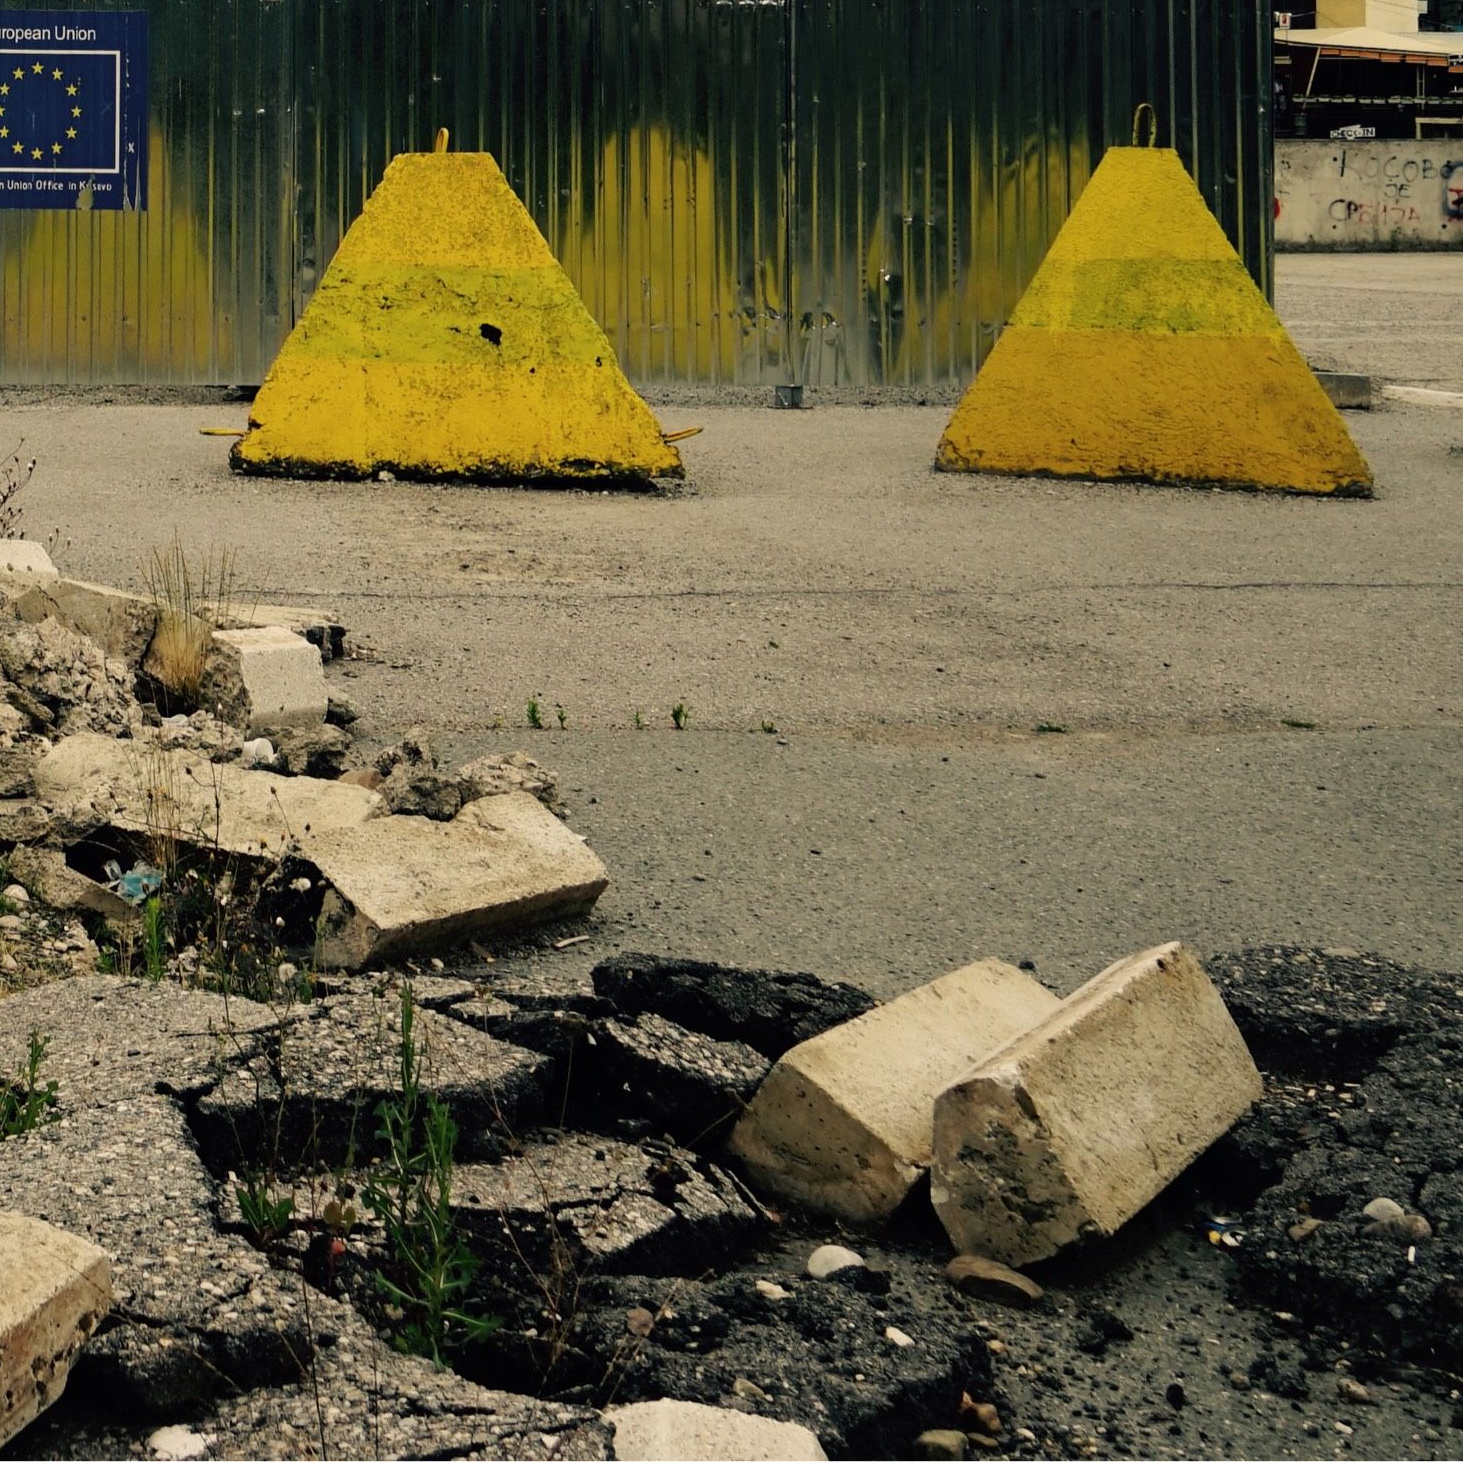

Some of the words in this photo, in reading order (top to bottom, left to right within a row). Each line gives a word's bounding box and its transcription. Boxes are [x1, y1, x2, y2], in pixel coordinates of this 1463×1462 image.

[54, 25, 97, 41] Union
[7, 179, 33, 191] Union
[35, 179, 64, 191] Office
[68, 180, 77, 191] in
[79, 180, 112, 192] Ksovo
